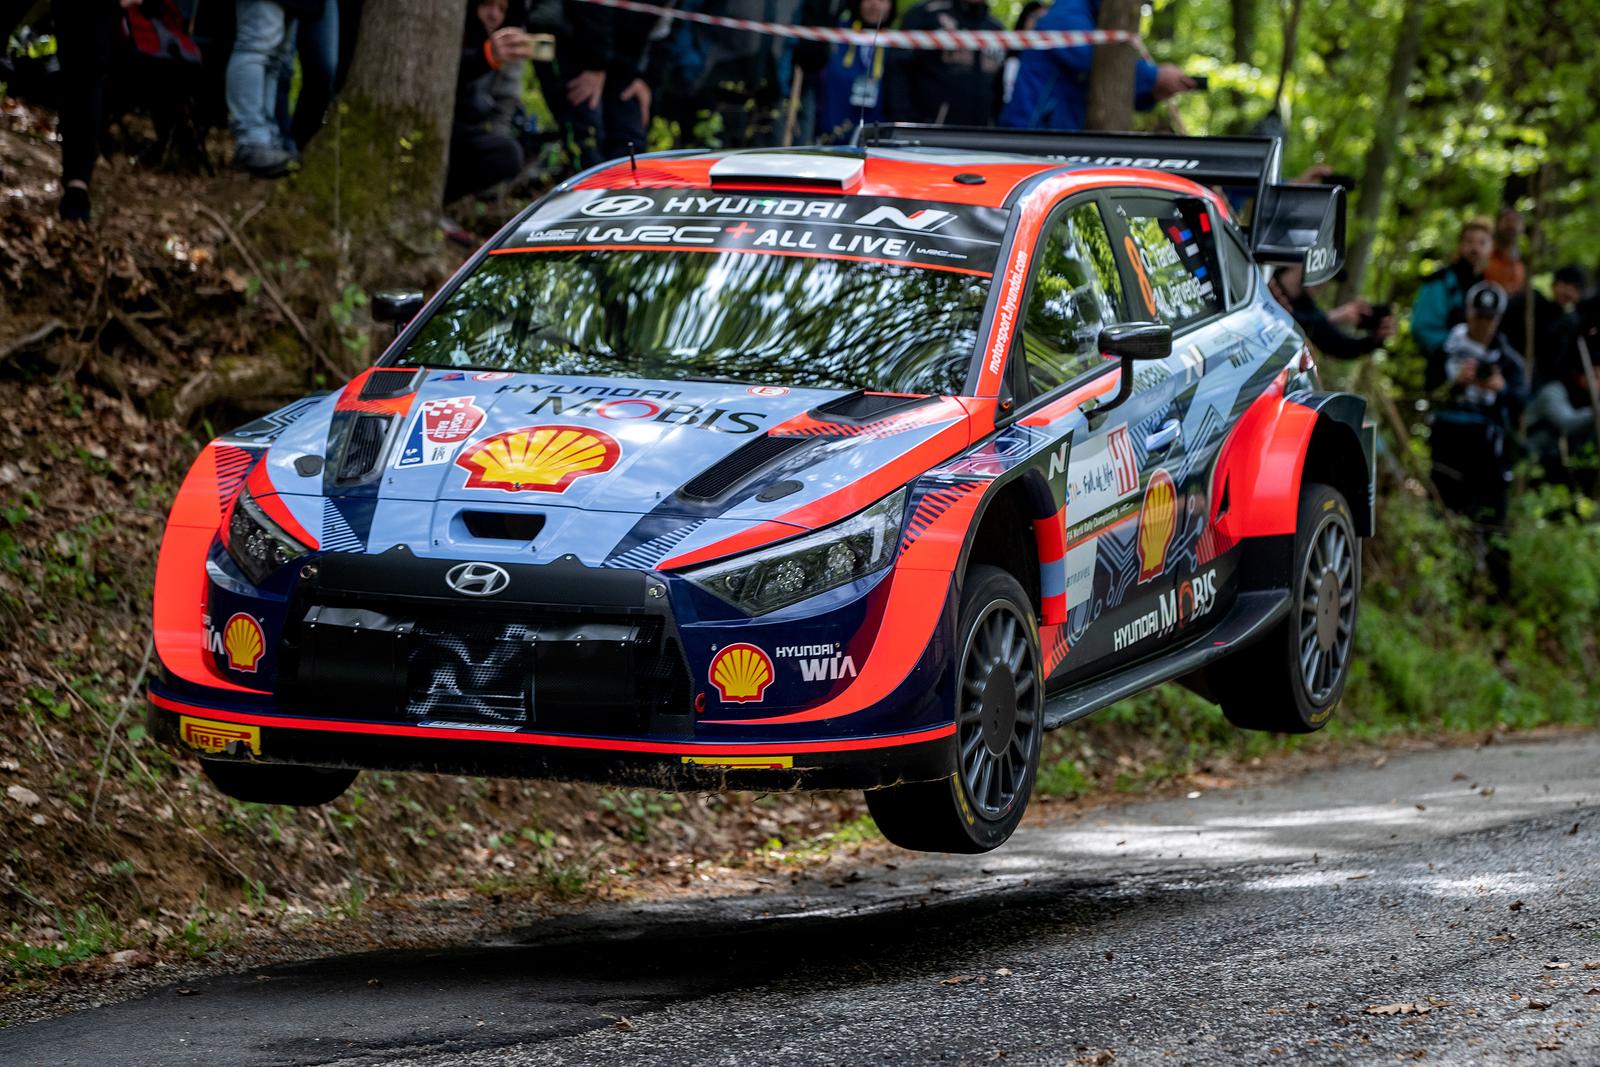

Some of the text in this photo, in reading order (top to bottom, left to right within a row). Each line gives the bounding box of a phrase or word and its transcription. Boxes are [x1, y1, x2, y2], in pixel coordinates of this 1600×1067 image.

[661, 196, 848, 220] HYUNDAI
[752, 228, 817, 249] ALL
[827, 233, 908, 257] LIVE
[1123, 235, 1157, 317] 8
[988, 249, 1028, 375] motorsport.hyundai.com
[494, 383, 683, 400] HYUNDAI
[445, 411, 468, 439] CROATIA
[527, 396, 768, 435] MOBIS
[1156, 568, 1218, 638] MOBIS
[1113, 610, 1159, 652] HYUNDAI
[775, 643, 834, 658] HYUNDAI
[799, 651, 858, 682] WIA
[185, 722, 252, 750] PIRE
